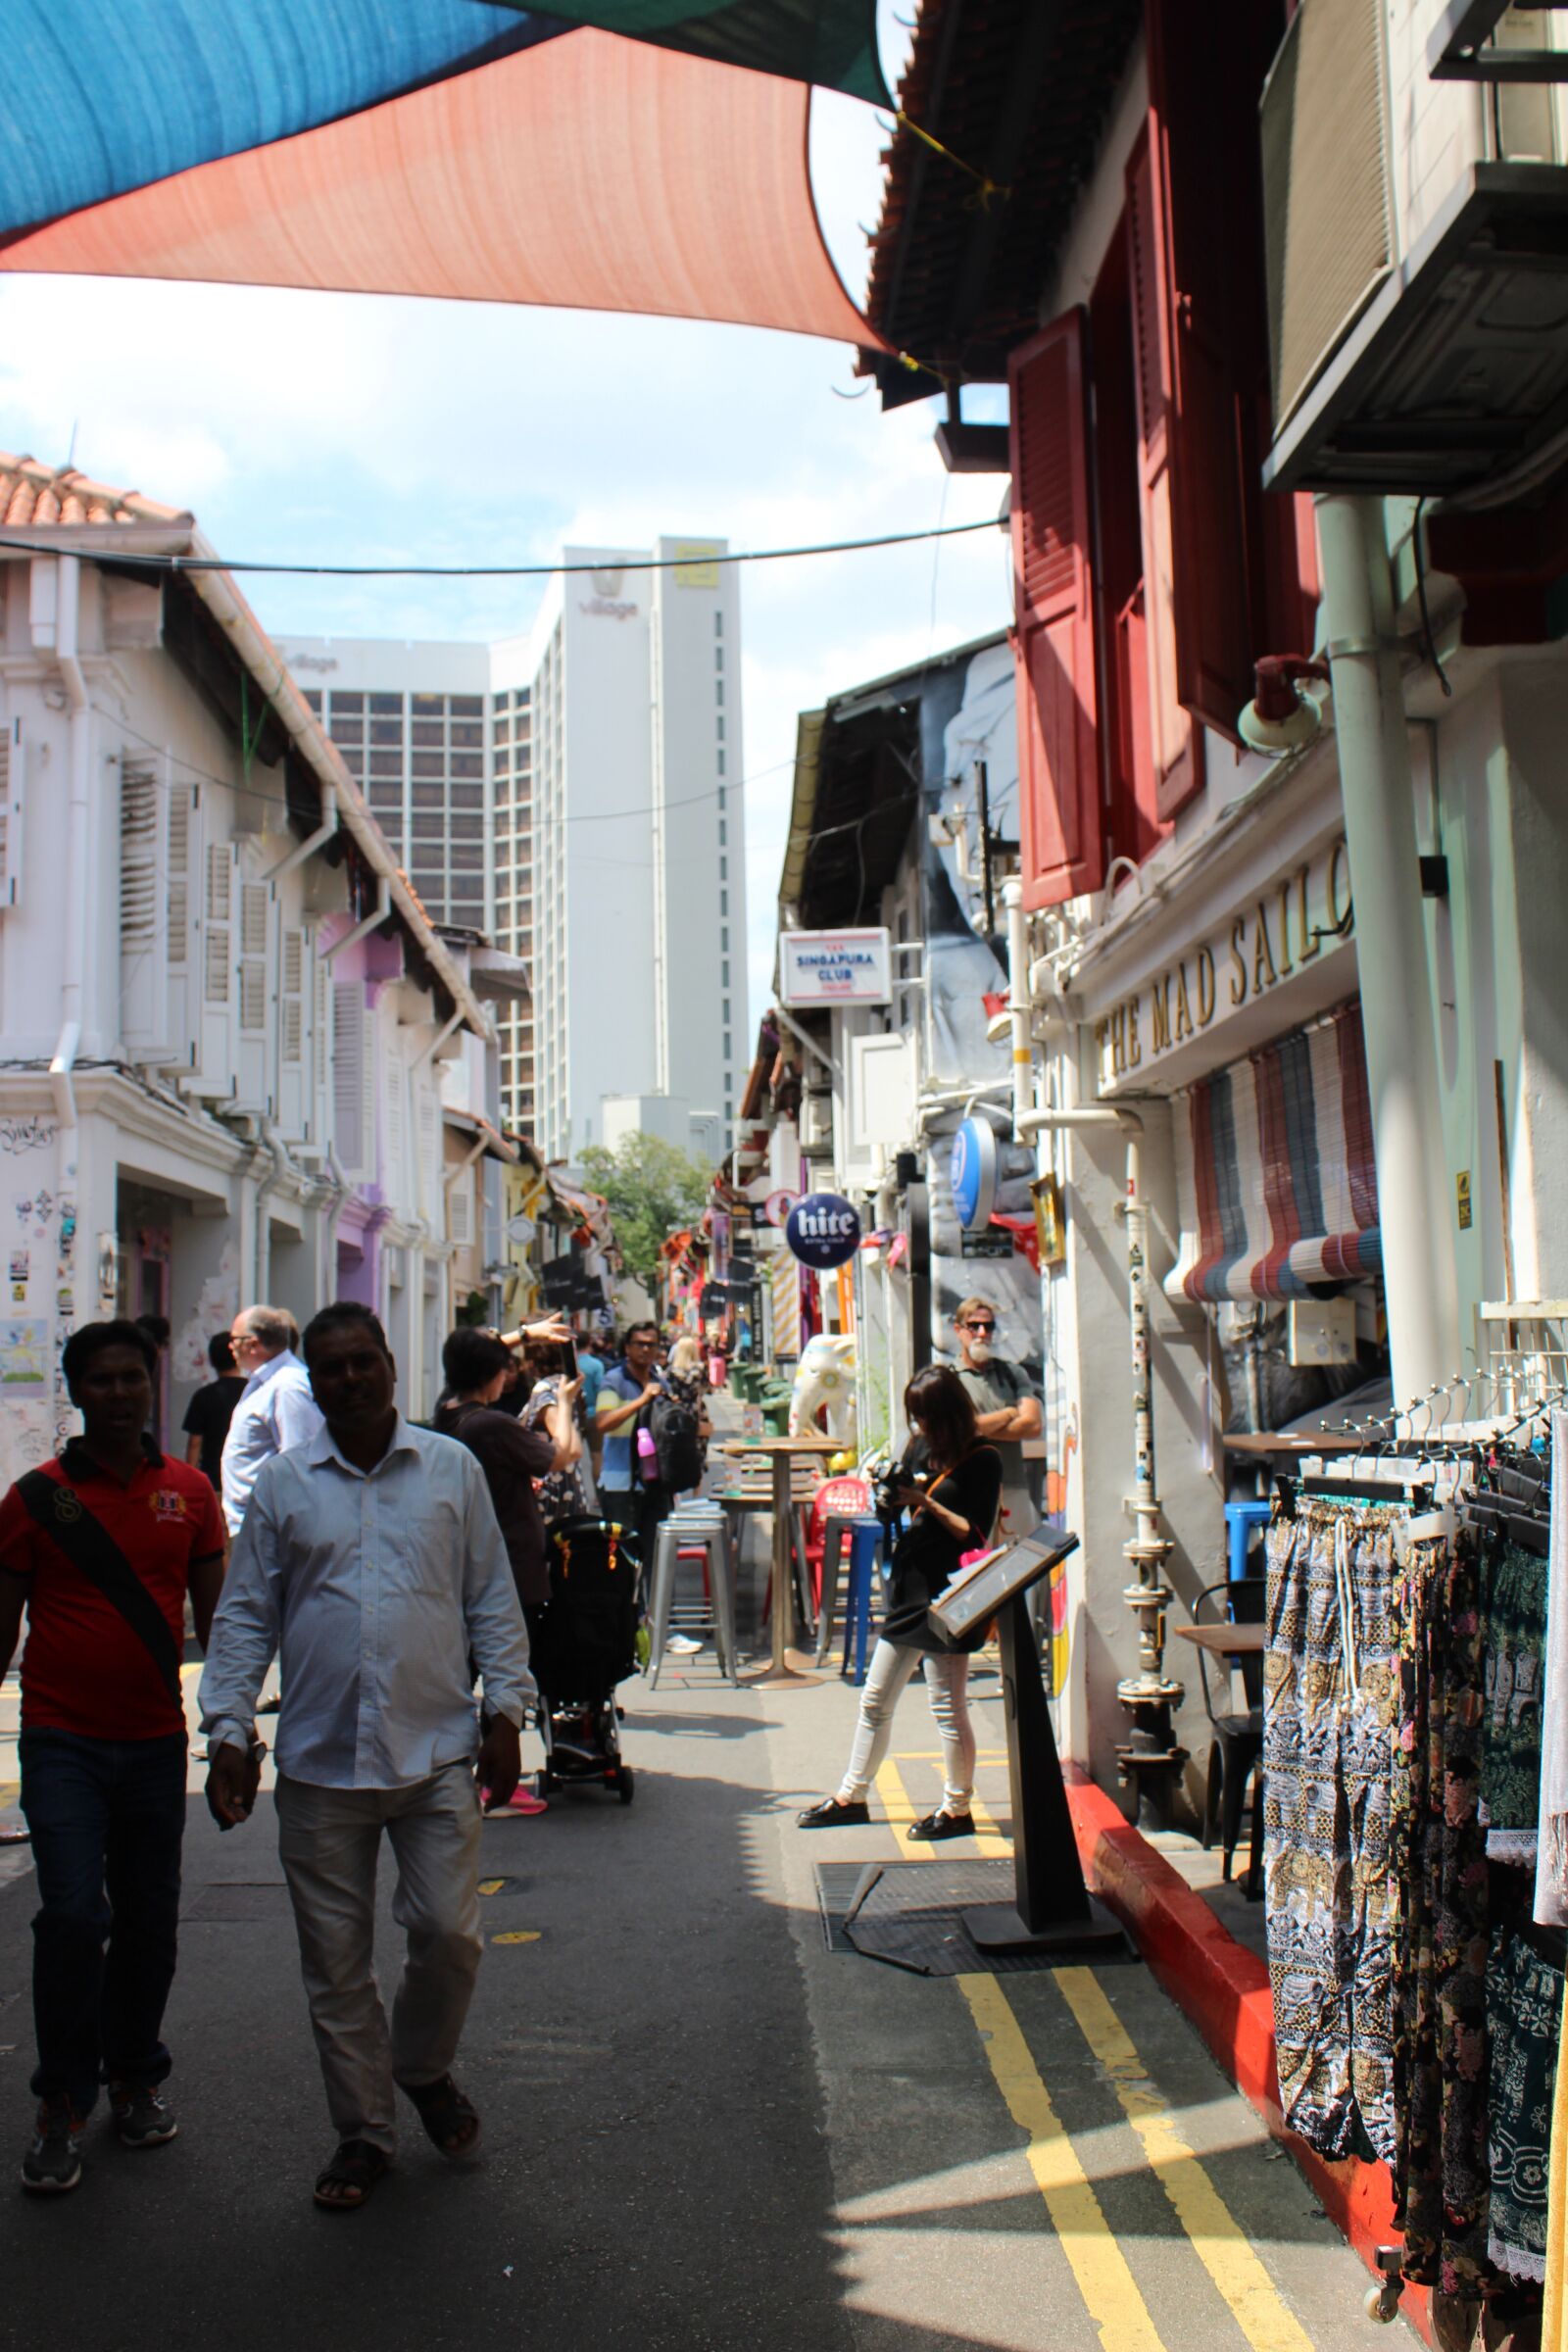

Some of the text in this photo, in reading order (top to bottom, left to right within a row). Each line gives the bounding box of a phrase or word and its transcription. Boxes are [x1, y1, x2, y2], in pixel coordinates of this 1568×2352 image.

[797, 954, 874, 967] SINGAPURA
[818, 968, 853, 982] CLUB
[1095, 997, 1142, 1083] THE
[1152, 945, 1215, 1054] MAD
[797, 1206, 856, 1237] hite
